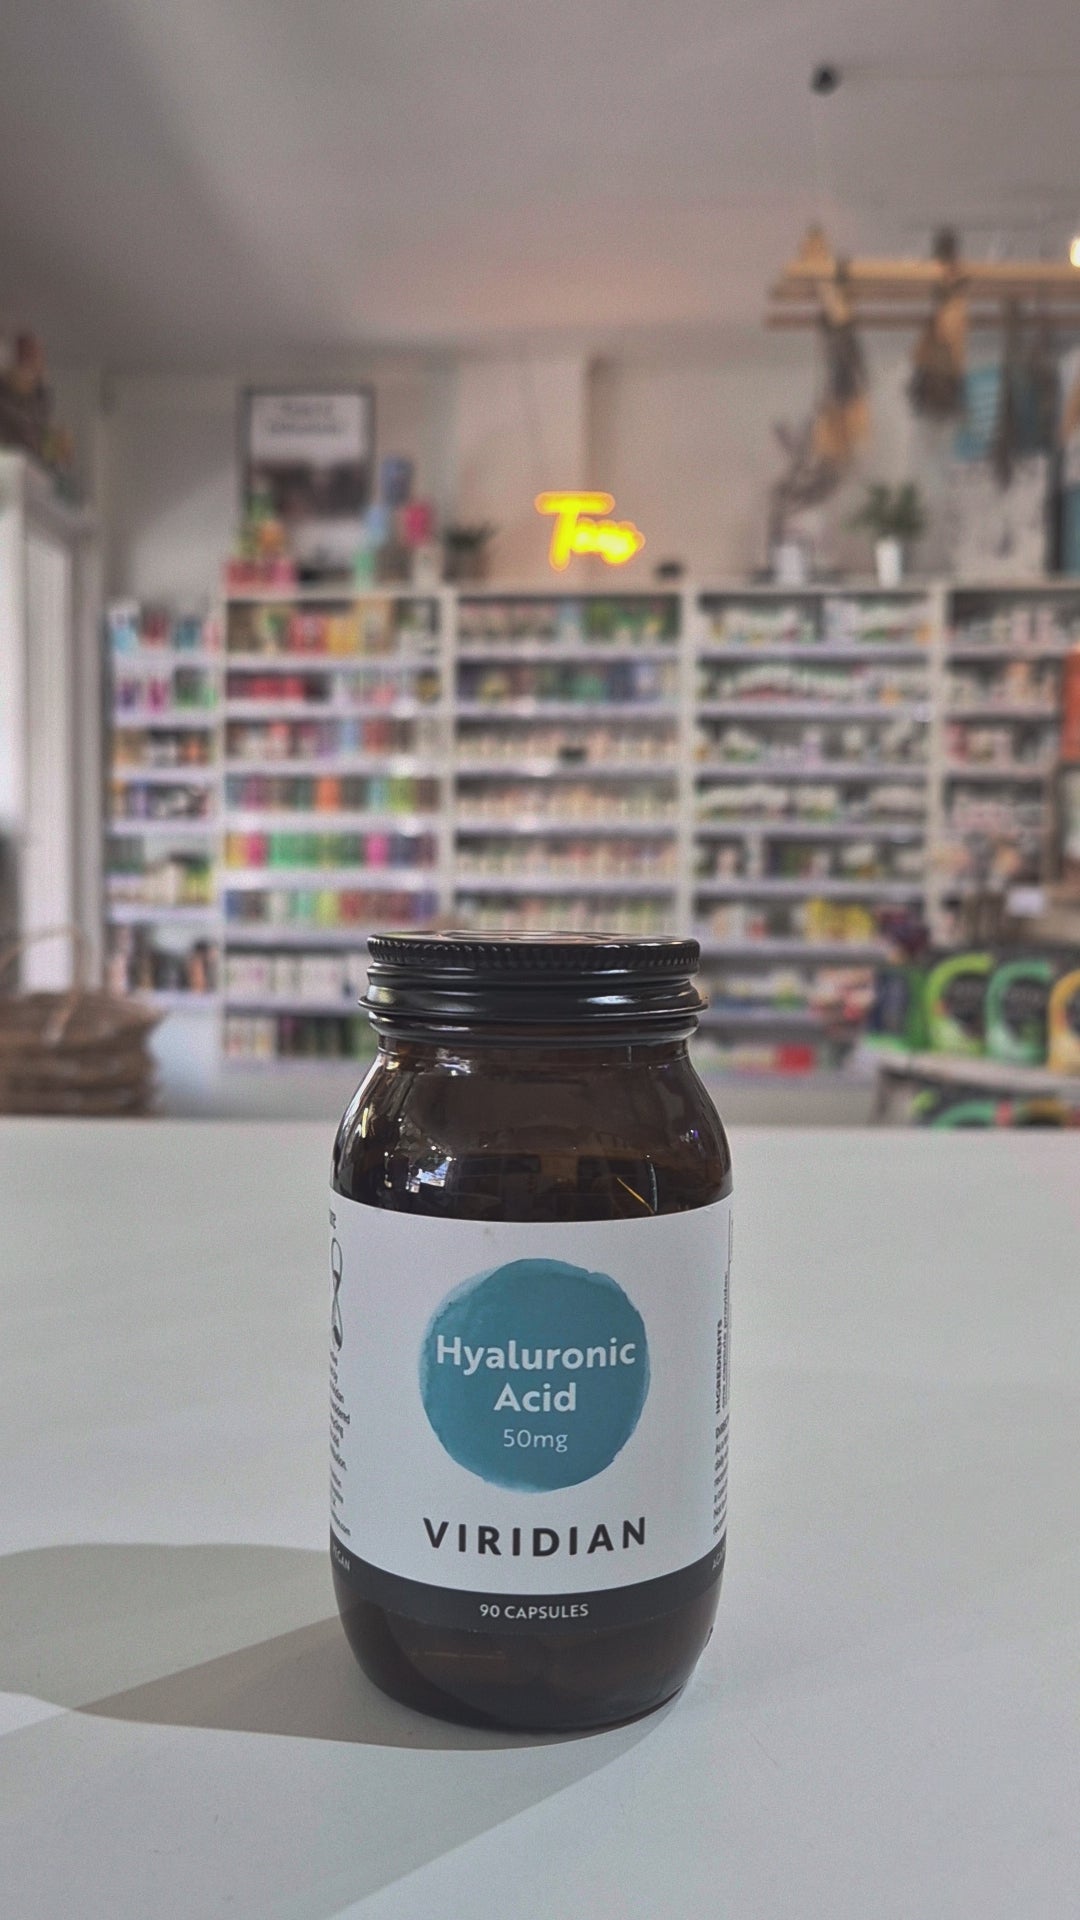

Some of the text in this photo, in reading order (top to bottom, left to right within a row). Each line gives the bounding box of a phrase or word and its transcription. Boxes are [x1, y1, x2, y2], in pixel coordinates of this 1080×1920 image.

[436, 1334, 636, 1376] Hyaluronic
[493, 1382, 577, 1412] Acid
[503, 1429, 569, 1453] 50mg
[423, 1516, 646, 1557] VIRIDIAN
[479, 1603, 589, 1619] 90 CAPSULES
